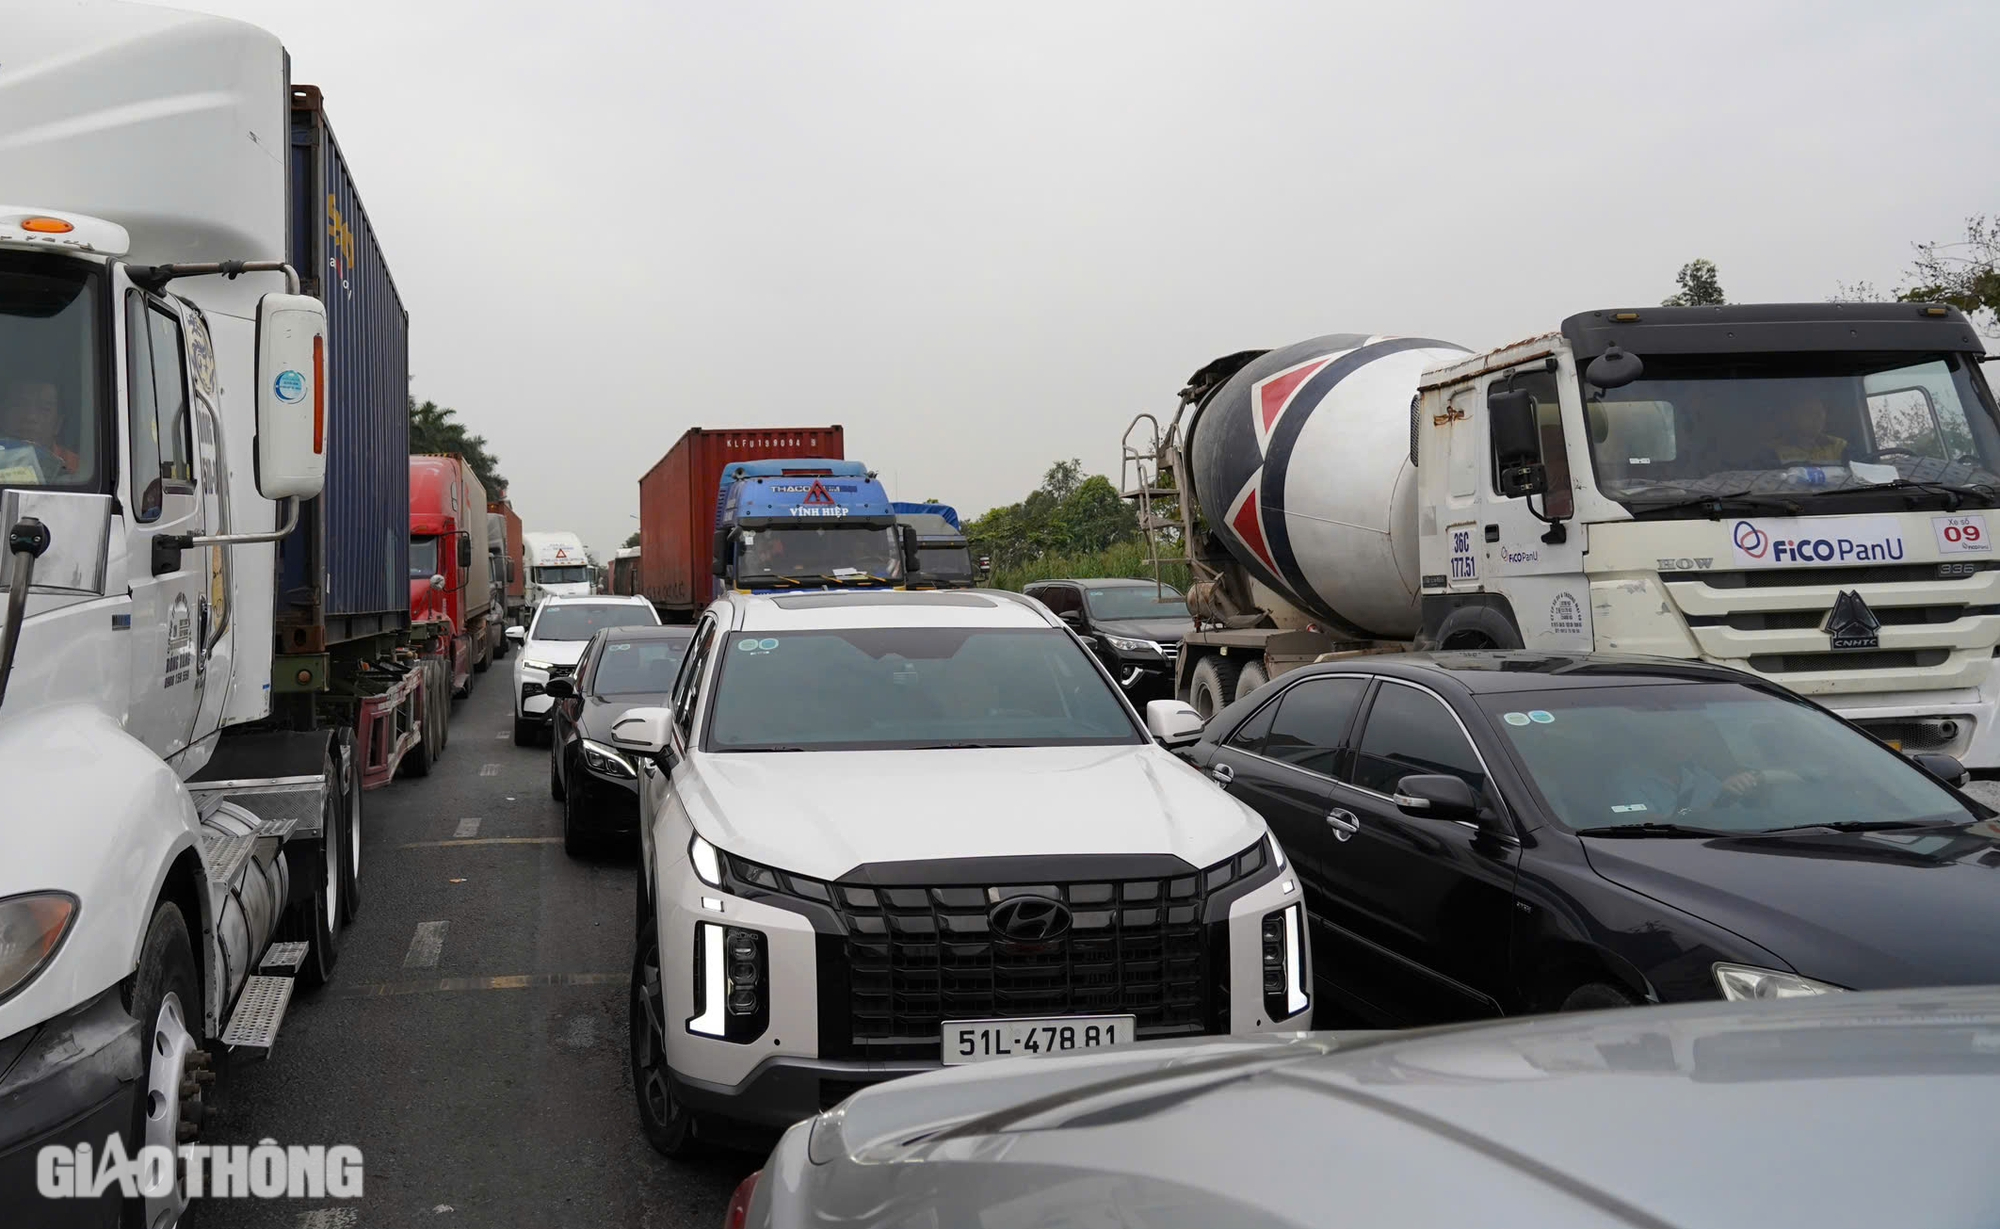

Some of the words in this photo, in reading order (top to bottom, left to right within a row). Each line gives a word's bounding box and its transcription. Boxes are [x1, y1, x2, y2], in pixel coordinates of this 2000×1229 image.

[771, 485, 811, 493] THACO
[821, 505, 849, 518] HIỆP
[1943, 525, 1981, 543] 09
[1453, 532, 1470, 553] 36C
[1450, 556, 1476, 578] 177.51
[1656, 557, 1714, 570] HOW
[1940, 563, 1974, 574] 336
[1834, 638, 1877, 647] CNHTC
[959, 1024, 1115, 1056] 51L-47881
